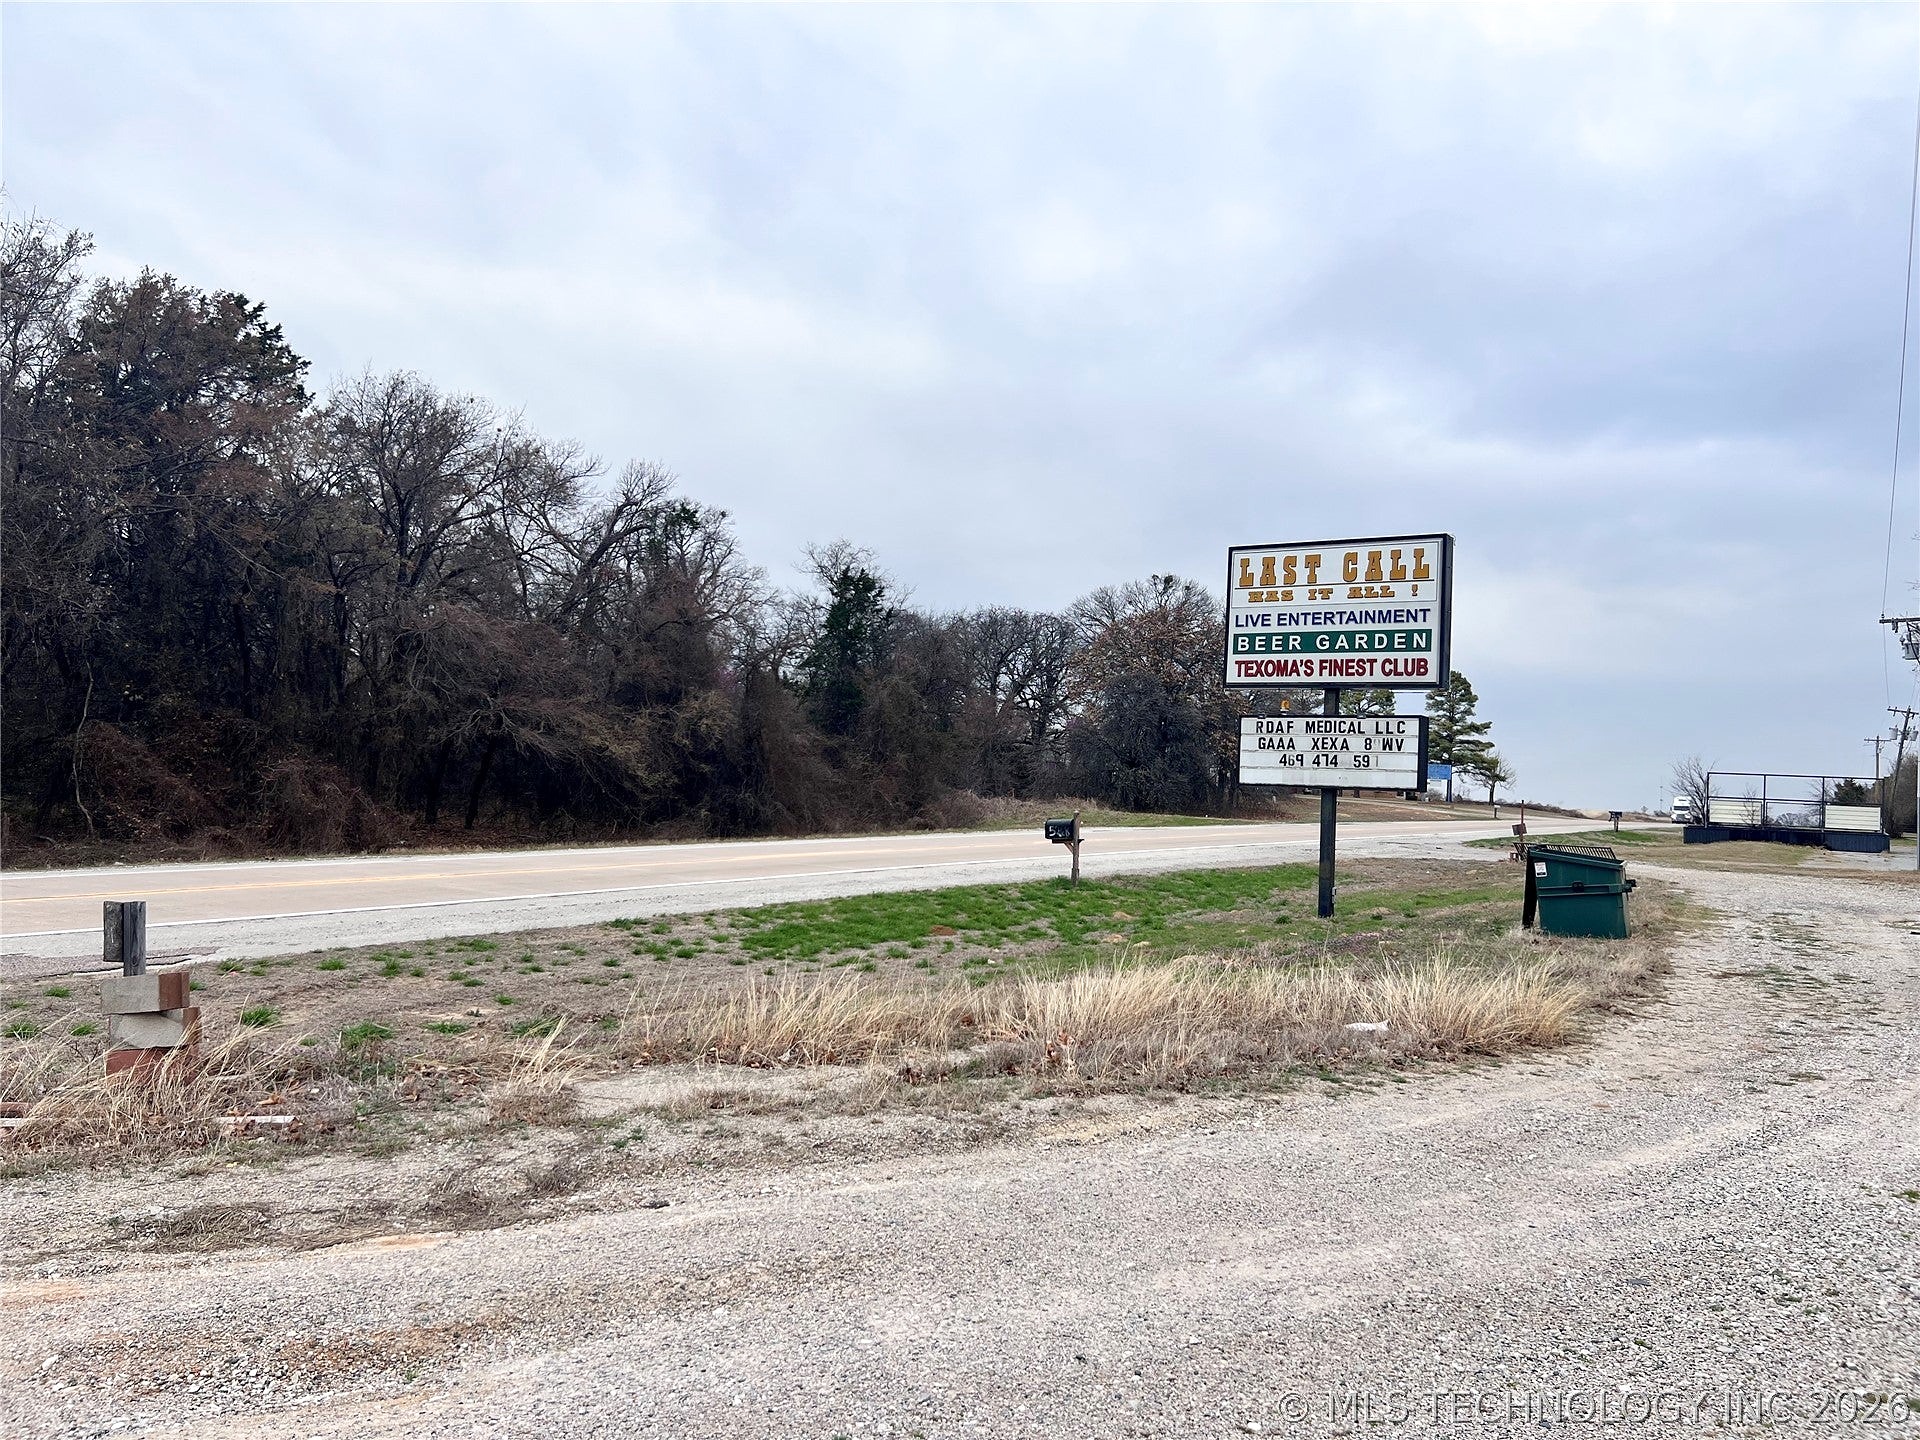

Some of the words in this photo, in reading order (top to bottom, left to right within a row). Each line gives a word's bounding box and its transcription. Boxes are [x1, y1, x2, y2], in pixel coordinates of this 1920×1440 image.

[1239, 554, 1321, 587] LAST
[1343, 548, 1430, 582] CALL
[1248, 590, 1294, 602] HAS
[1308, 587, 1333, 600] IT
[1347, 585, 1395, 599] ALL
[1235, 614, 1271, 628] LIVE
[1277, 608, 1431, 626] ENTERTAINMENT
[1237, 636, 1302, 651] BEER
[1316, 632, 1426, 650] GARDEN
[1235, 658, 1314, 677] TEXOMA'S
[1319, 658, 1377, 677] FINEST
[1381, 657, 1429, 676] CLUB
[1256, 720, 1294, 734] RDAF
[1305, 720, 1366, 734] MEDICAL
[1375, 720, 1406, 734] LLC
[1258, 737, 1296, 750] GAAA
[1311, 737, 1350, 751] XEXA
